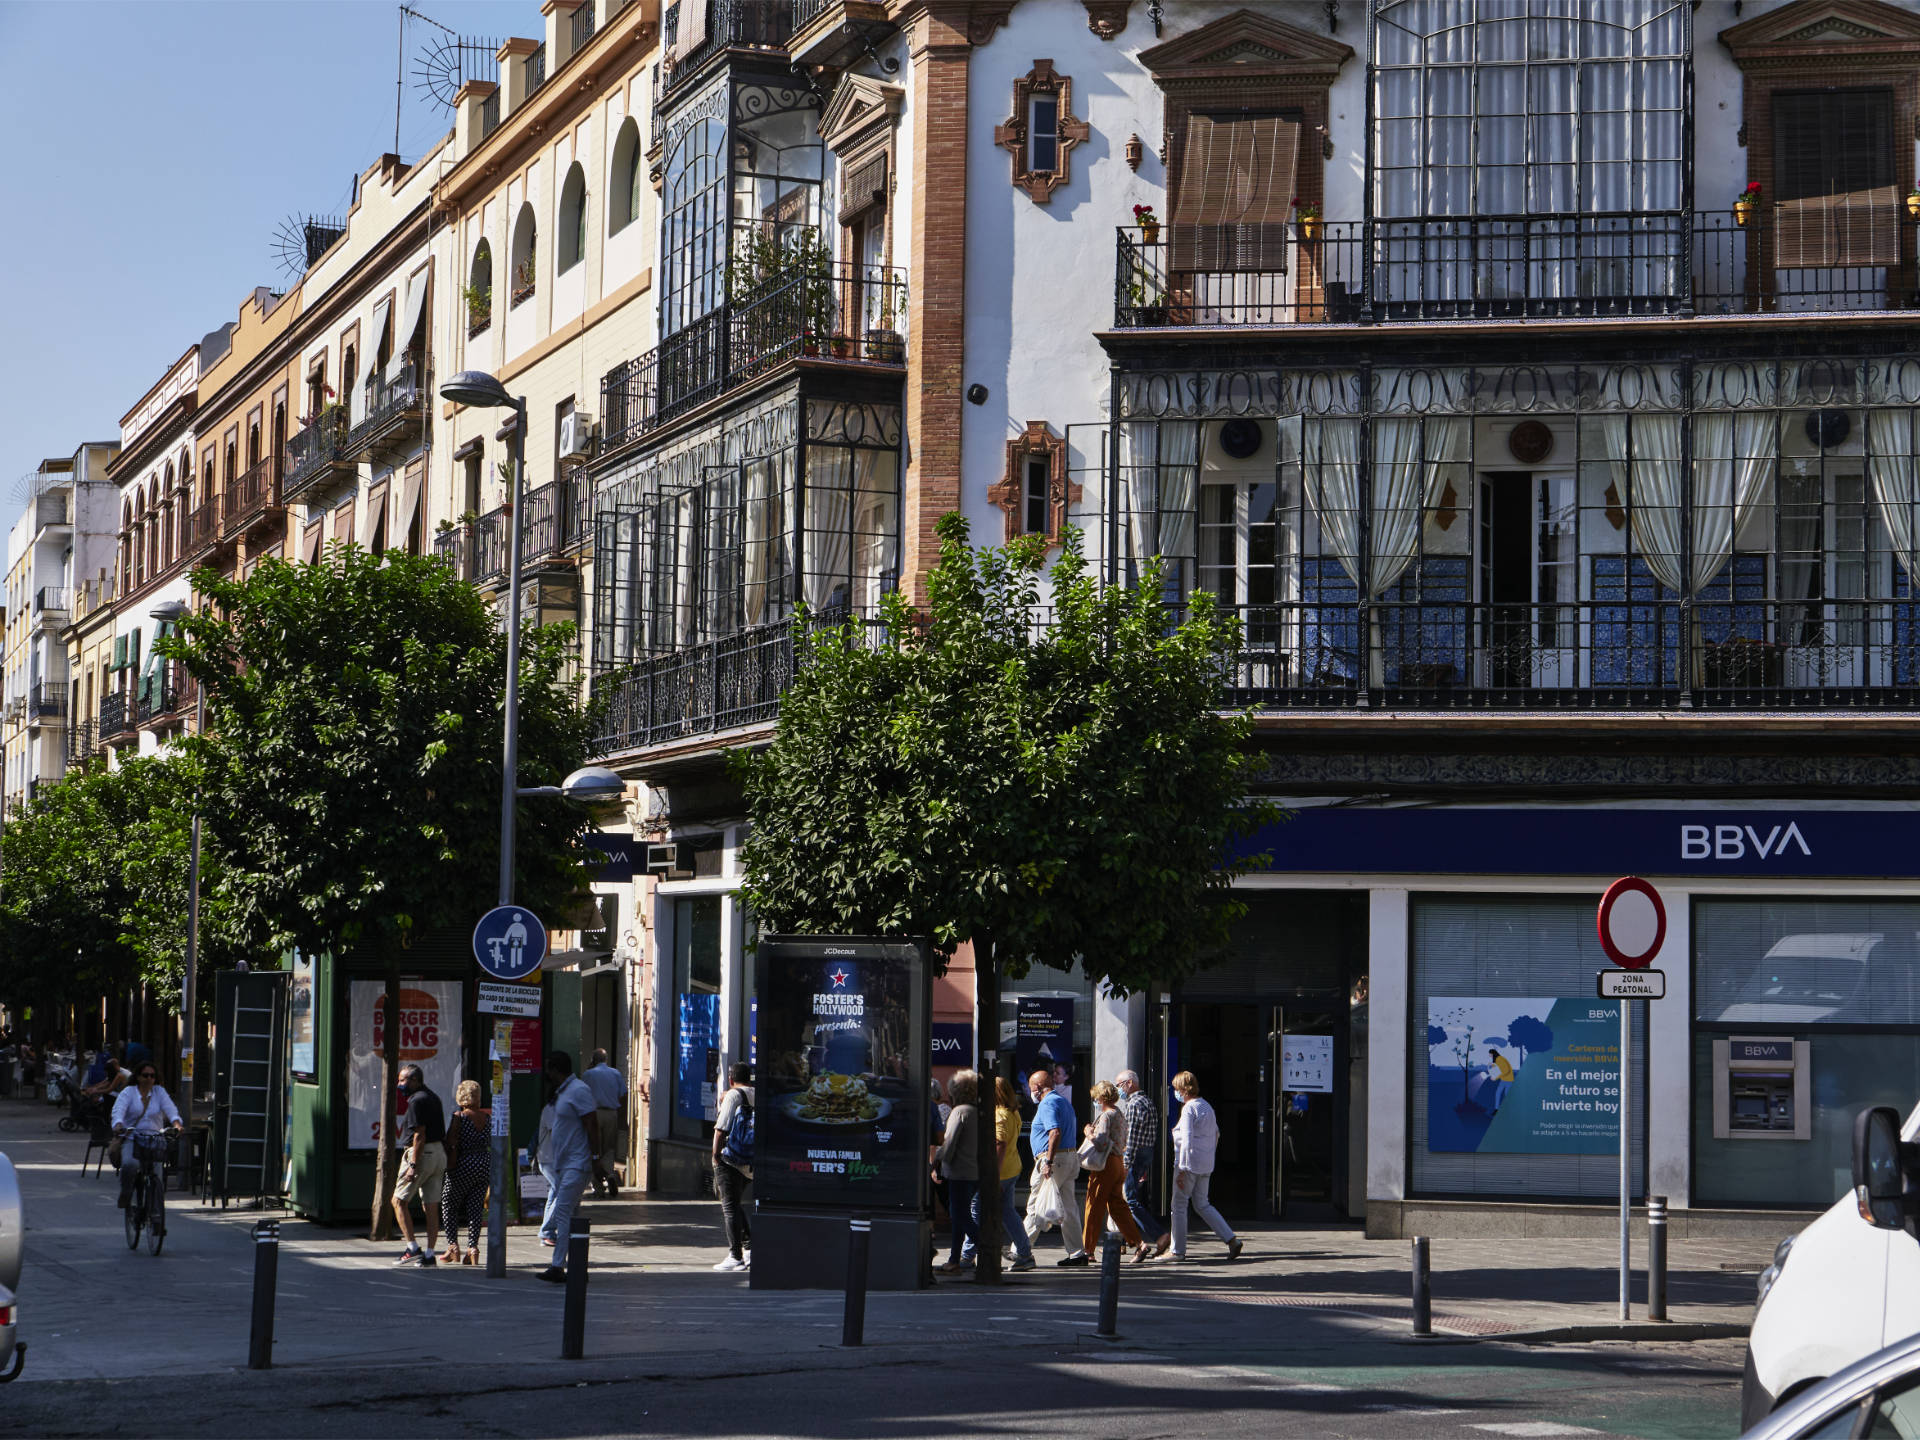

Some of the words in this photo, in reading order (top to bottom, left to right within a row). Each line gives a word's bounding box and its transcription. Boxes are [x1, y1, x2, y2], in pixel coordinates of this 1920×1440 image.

[1681, 821, 1811, 860] BBVA
[1622, 975, 1644, 983] ZONA
[481, 984, 504, 992] DESMONTE
[518, 988, 540, 996] BICICLETA
[813, 994, 864, 1004] FOSTER'S
[500, 1005, 523, 1013] PERSONAS
[812, 1004, 864, 1015] HOLLYWOOD
[1588, 1009, 1618, 1018] BBVA
[373, 1011, 439, 1026] BRGER
[373, 1026, 439, 1047] KNG
[931, 1038, 961, 1050] BVA
[1568, 1044, 1605, 1053] Carteras
[1607, 1044, 1618, 1053] de
[1744, 1046, 1778, 1056] BBVA
[1594, 1055, 1618, 1063] BBVA
[1546, 1069, 1562, 1080] En
[1565, 1069, 1577, 1080] el
[1581, 1069, 1618, 1083] mejor
[1559, 1084, 1600, 1095] futuro
[1604, 1087, 1618, 1096] se
[1542, 1100, 1591, 1111] invierte
[1595, 1100, 1618, 1114] hoy
[807, 1149, 837, 1159] NUEVA
[838, 1151, 861, 1160] FAMILIA
[789, 1161, 845, 1173] FOSTER'S
